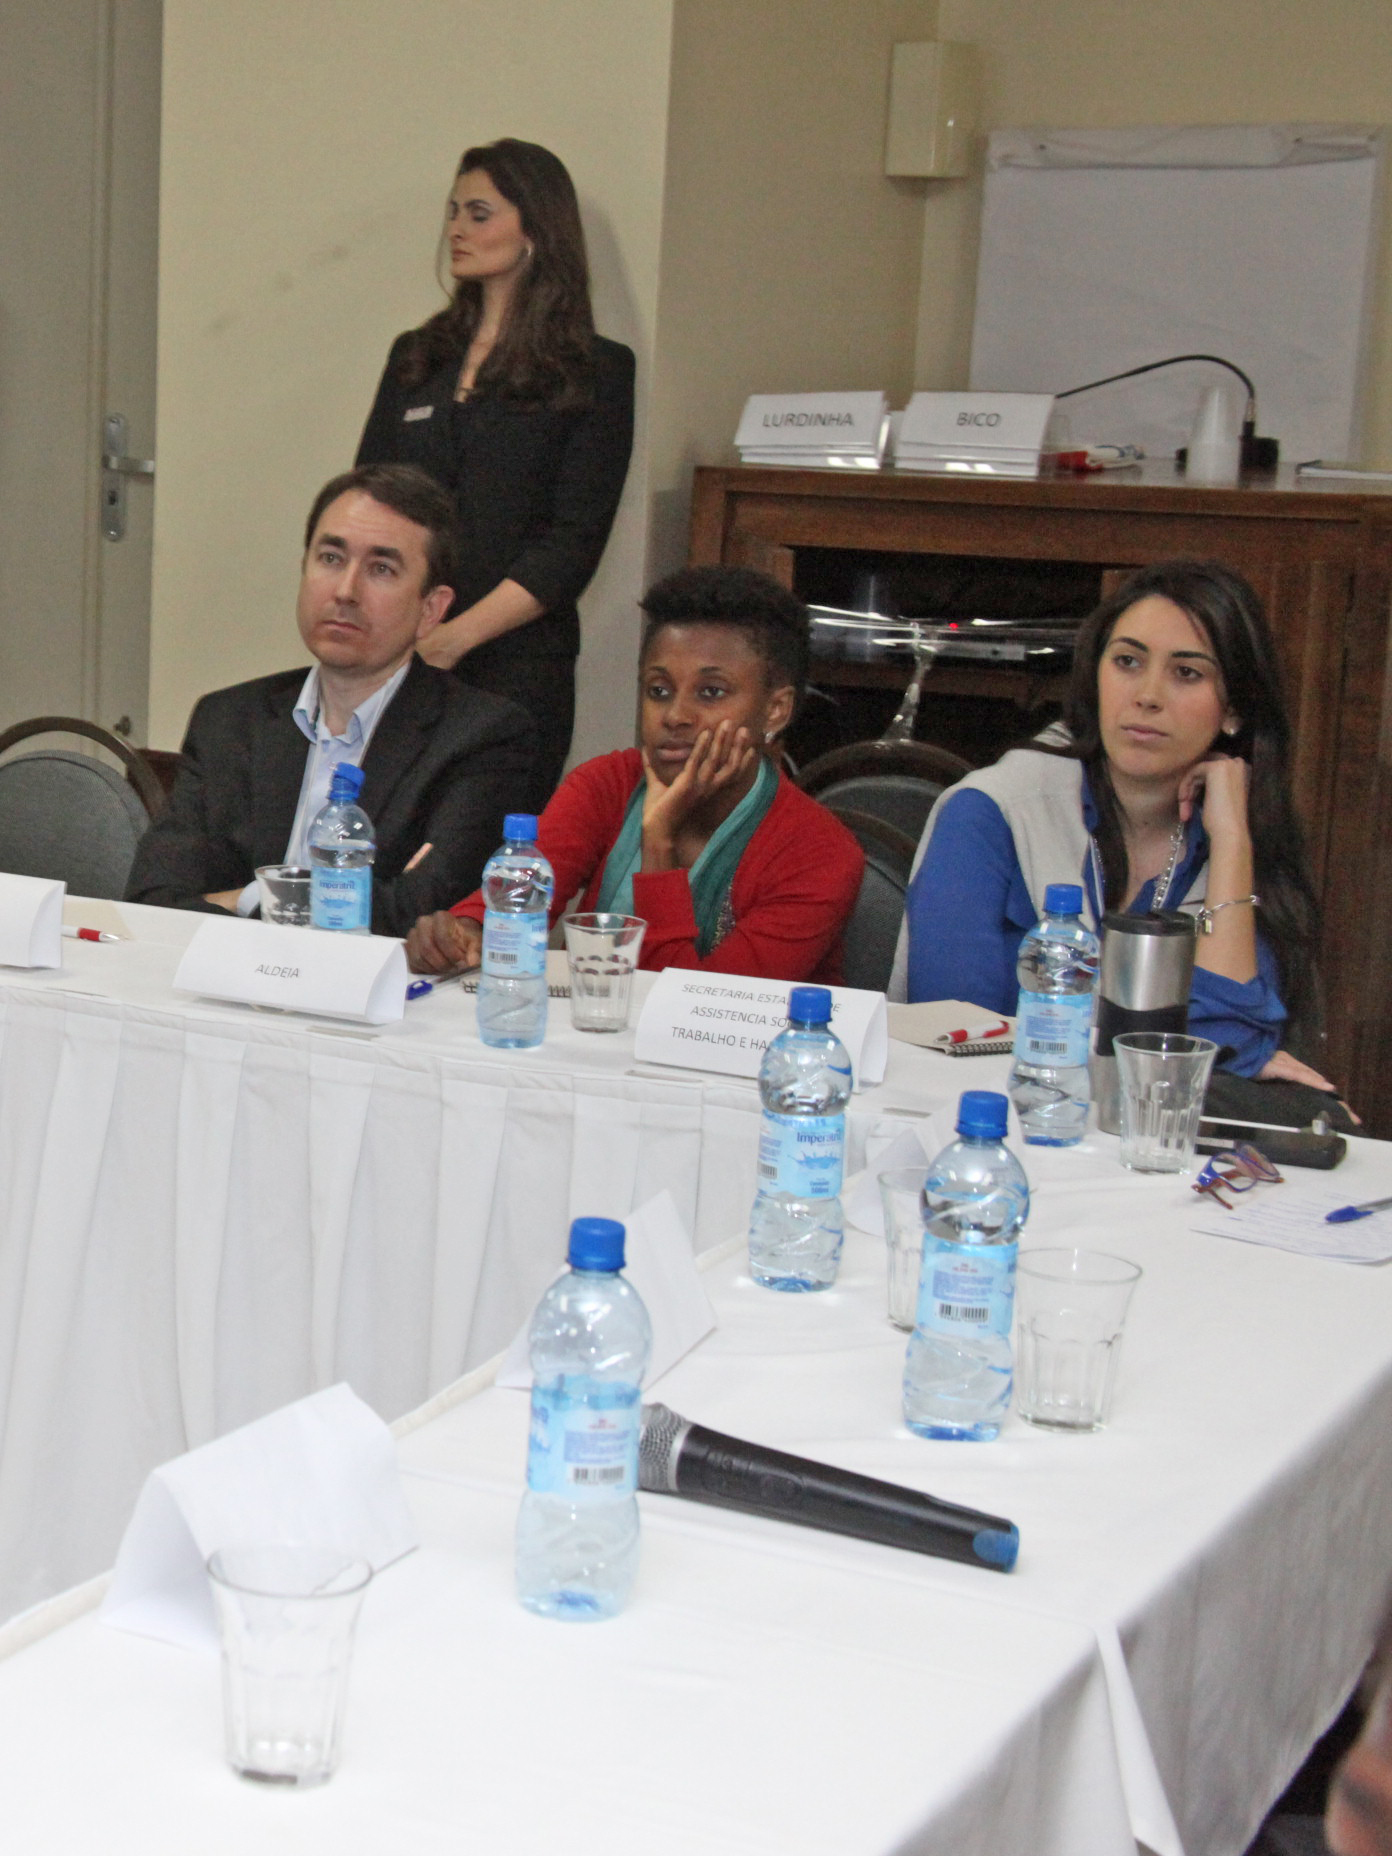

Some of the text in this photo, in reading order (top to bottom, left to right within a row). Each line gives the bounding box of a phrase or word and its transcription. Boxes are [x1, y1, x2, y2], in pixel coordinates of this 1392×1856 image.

[762, 412, 855, 427] LURDINHA
[956, 412, 1001, 427] BICO
[254, 964, 300, 978] ALDEIA
[681, 983, 754, 1001] SECRETARIA
[690, 1005, 767, 1026] ASSISTENCIA
[671, 1026, 736, 1047] TRABALHO
[739, 1036, 747, 1048] E
